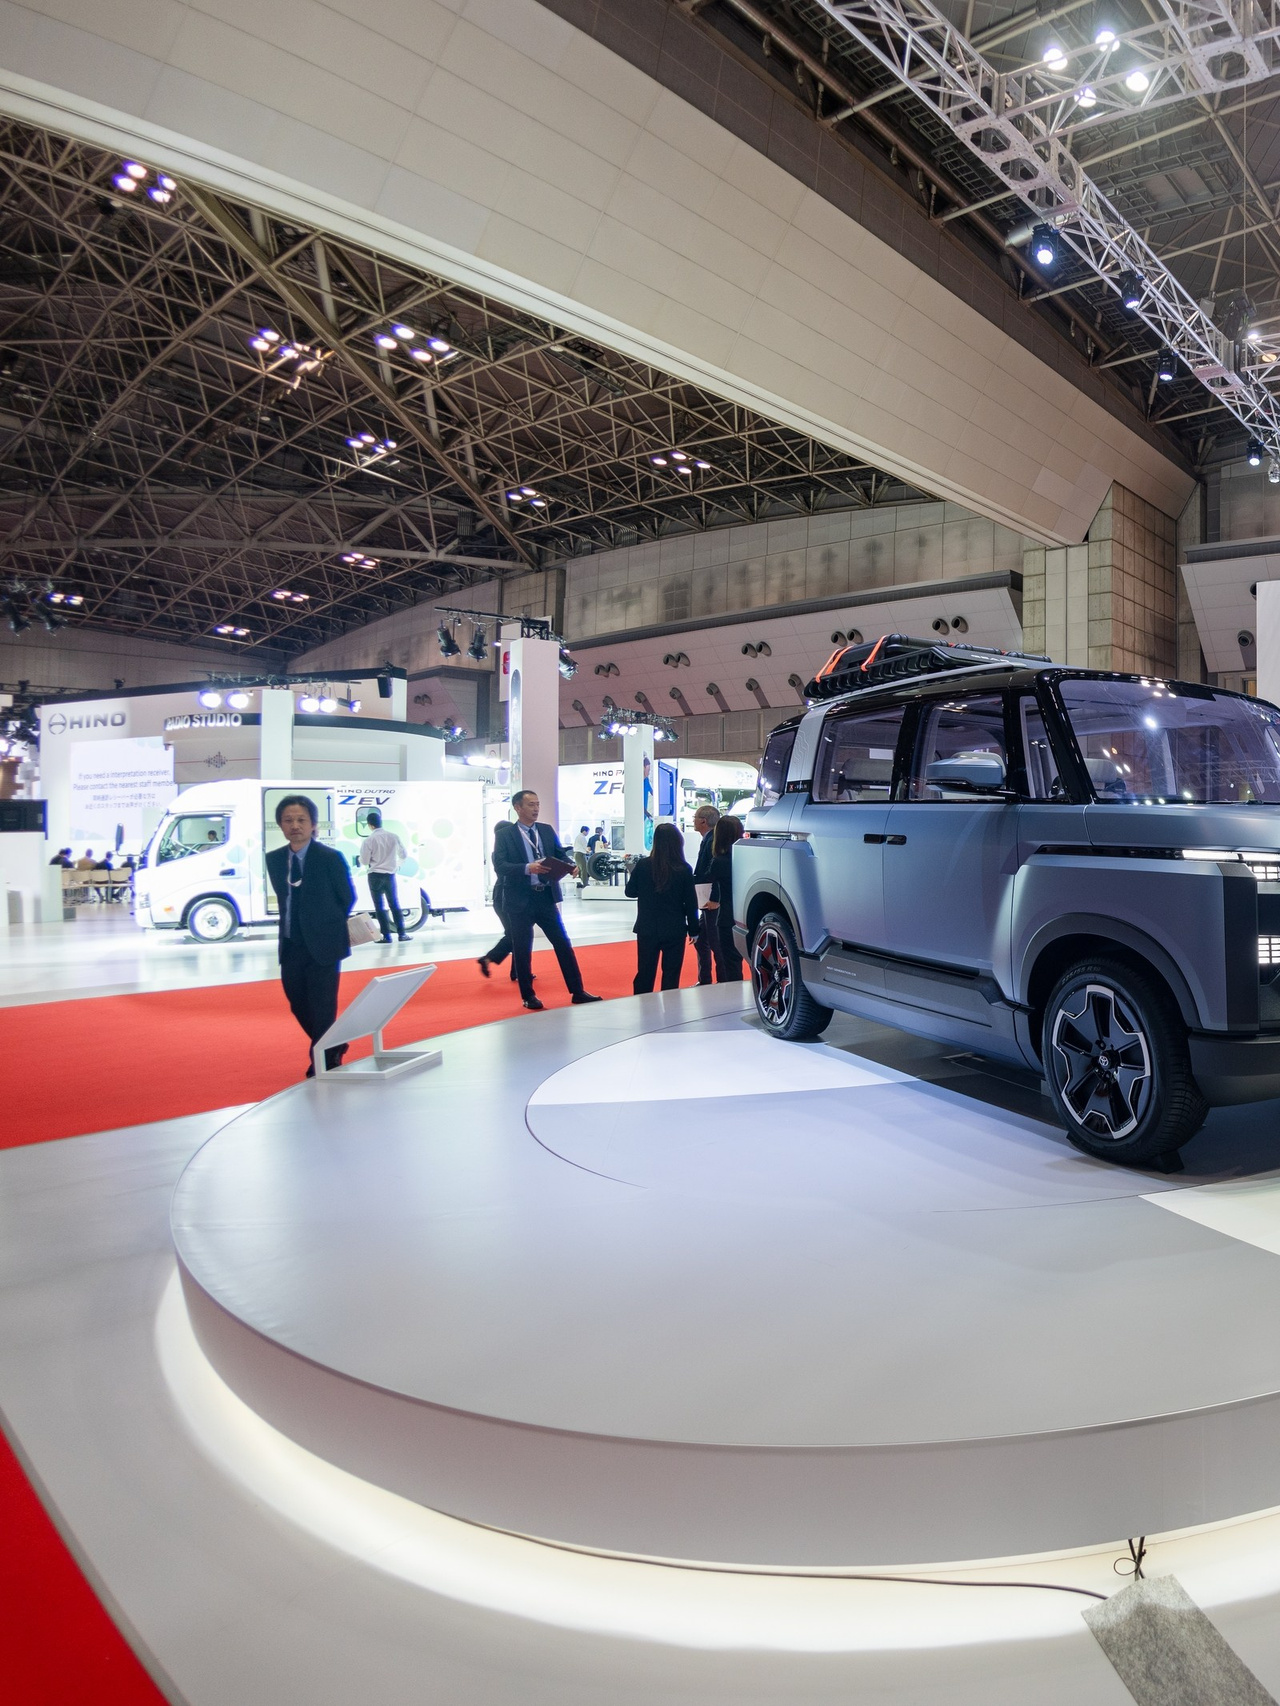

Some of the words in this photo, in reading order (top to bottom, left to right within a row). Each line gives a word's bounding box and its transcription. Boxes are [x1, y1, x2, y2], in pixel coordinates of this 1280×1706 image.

[69, 711, 126, 729] HINO
[191, 713, 242, 728] STUDIO
[337, 795, 391, 806] ZEV
